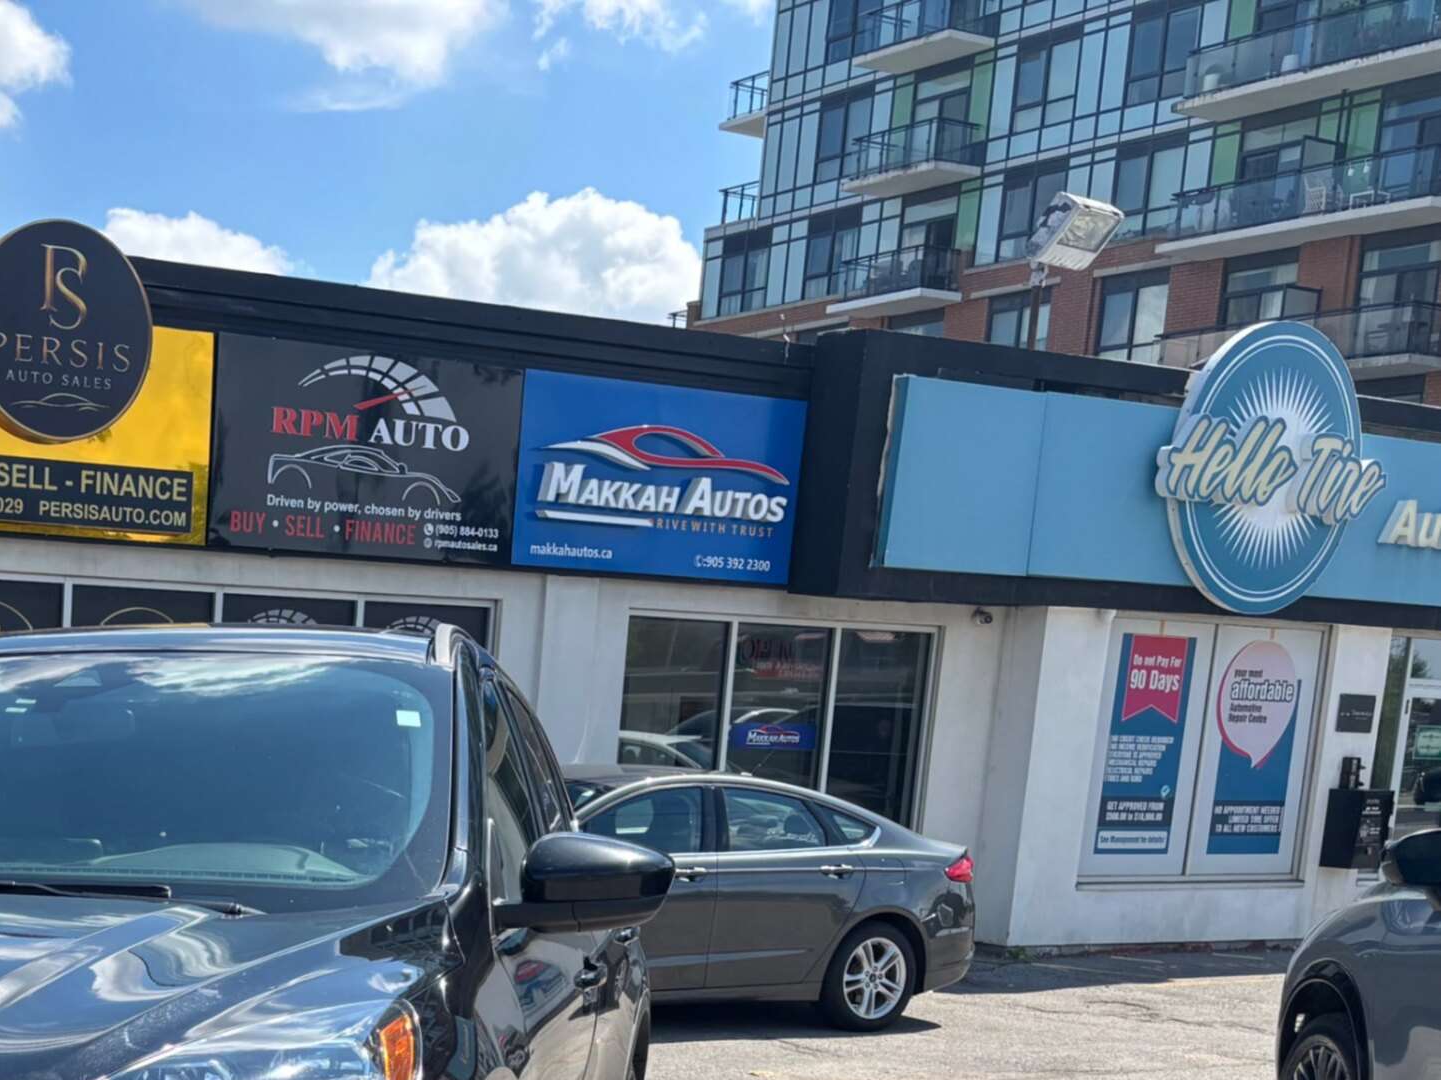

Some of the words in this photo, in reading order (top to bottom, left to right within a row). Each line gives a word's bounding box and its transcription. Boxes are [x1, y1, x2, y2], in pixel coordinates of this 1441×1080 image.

[5, 369, 53, 384] AUTO
[61, 374, 112, 390] SALES
[271, 406, 361, 442] RPM
[368, 417, 470, 452] AUTO
[1163, 416, 1299, 506] Hello
[80, 470, 188, 501] FINANCE
[539, 461, 681, 514] MAKKAH
[679, 477, 788, 523] AUTOS
[39, 500, 187, 527] PERSISAUTO.COM
[266, 494, 304, 508] Driven
[307, 499, 321, 512] by
[324, 501, 362, 514] power,
[364, 505, 405, 518] chosen
[407, 507, 421, 521] by
[424, 508, 462, 522] drivers
[230, 510, 267, 534] BUY
[285, 515, 324, 538] SELL
[345, 519, 416, 546] FINANCE
[649, 517, 688, 532] RIVE
[691, 520, 726, 534] WITH
[732, 525, 774, 539] TRUST
[529, 542, 613, 560] makkahautos.ca
[726, 557, 744, 570] 392
[746, 559, 771, 572] 2300
[1130, 669, 1147, 689] 90
[1149, 669, 1180, 693] Days
[1231, 679, 1294, 702] affordable
